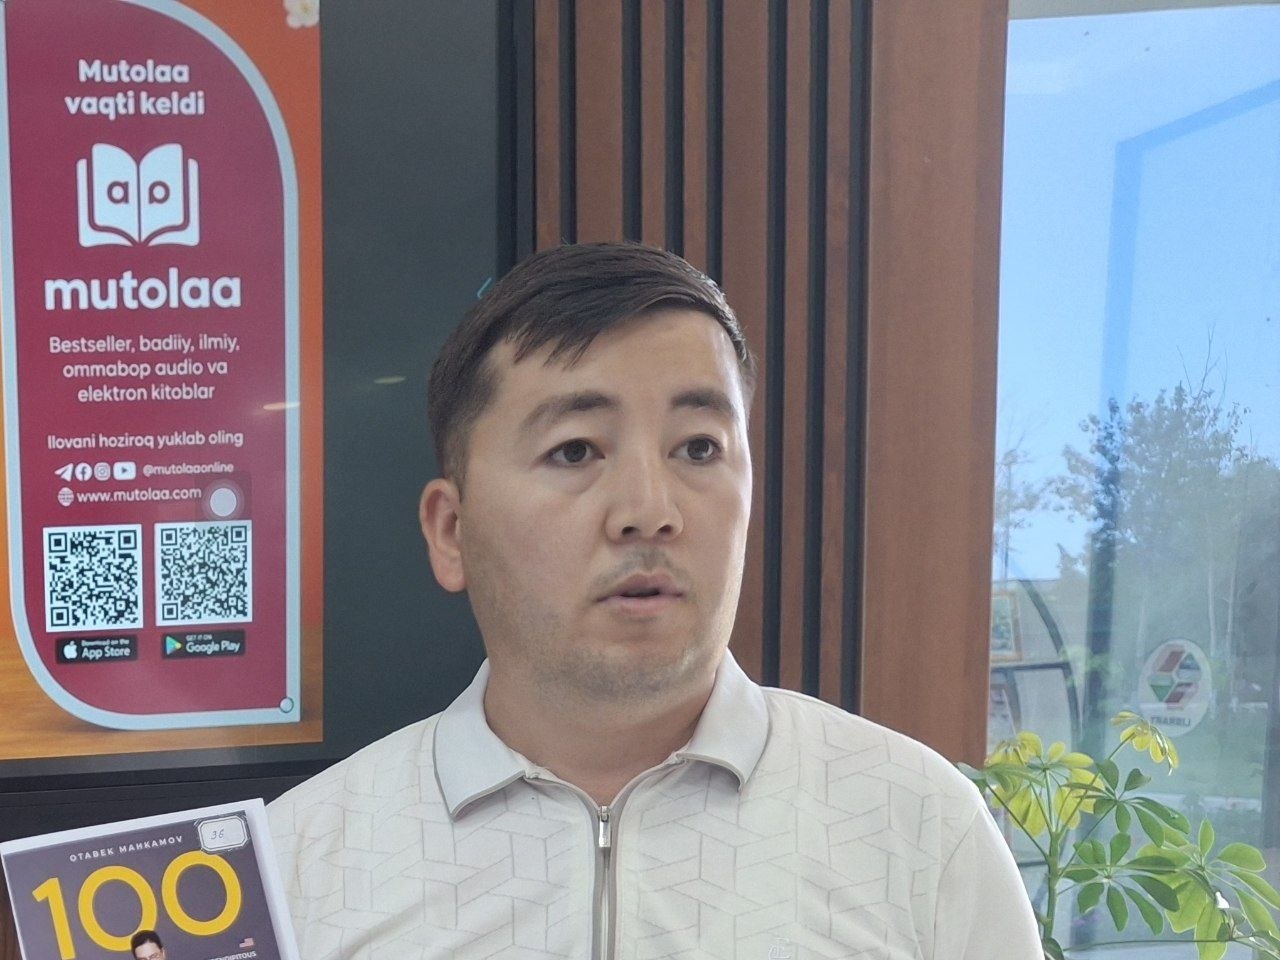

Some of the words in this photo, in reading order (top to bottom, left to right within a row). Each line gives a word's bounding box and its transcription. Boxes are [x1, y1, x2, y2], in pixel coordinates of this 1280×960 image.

[78, 58, 190, 84] Mutolaa
[64, 90, 135, 121] vaqti
[140, 90, 205, 115] keldi
[44, 267, 242, 310] mutolaa
[49, 335, 136, 354] Bestseller,
[139, 334, 195, 354] badiiy,
[62, 360, 151, 379] ommabop
[155, 360, 203, 376] audio
[207, 360, 228, 375] va
[77, 385, 147, 402] elektron
[151, 382, 215, 400] kitoblar
[47, 433, 96, 450] Ilovani
[99, 432, 154, 449] hoziroq
[157, 431, 205, 448] yuklab
[208, 430, 244, 447] oling
[142, 461, 234, 476] @mutolaaonline
[77, 487, 201, 503] www.mutolaa.com
[81, 647, 103, 660] App
[104, 645, 131, 658] Store
[186, 641, 220, 655] Google
[221, 640, 241, 653] Play
[70, 847, 114, 863] OTABEK
[119, 835, 183, 854] MAHKAMOV
[32, 850, 242, 960] 100
